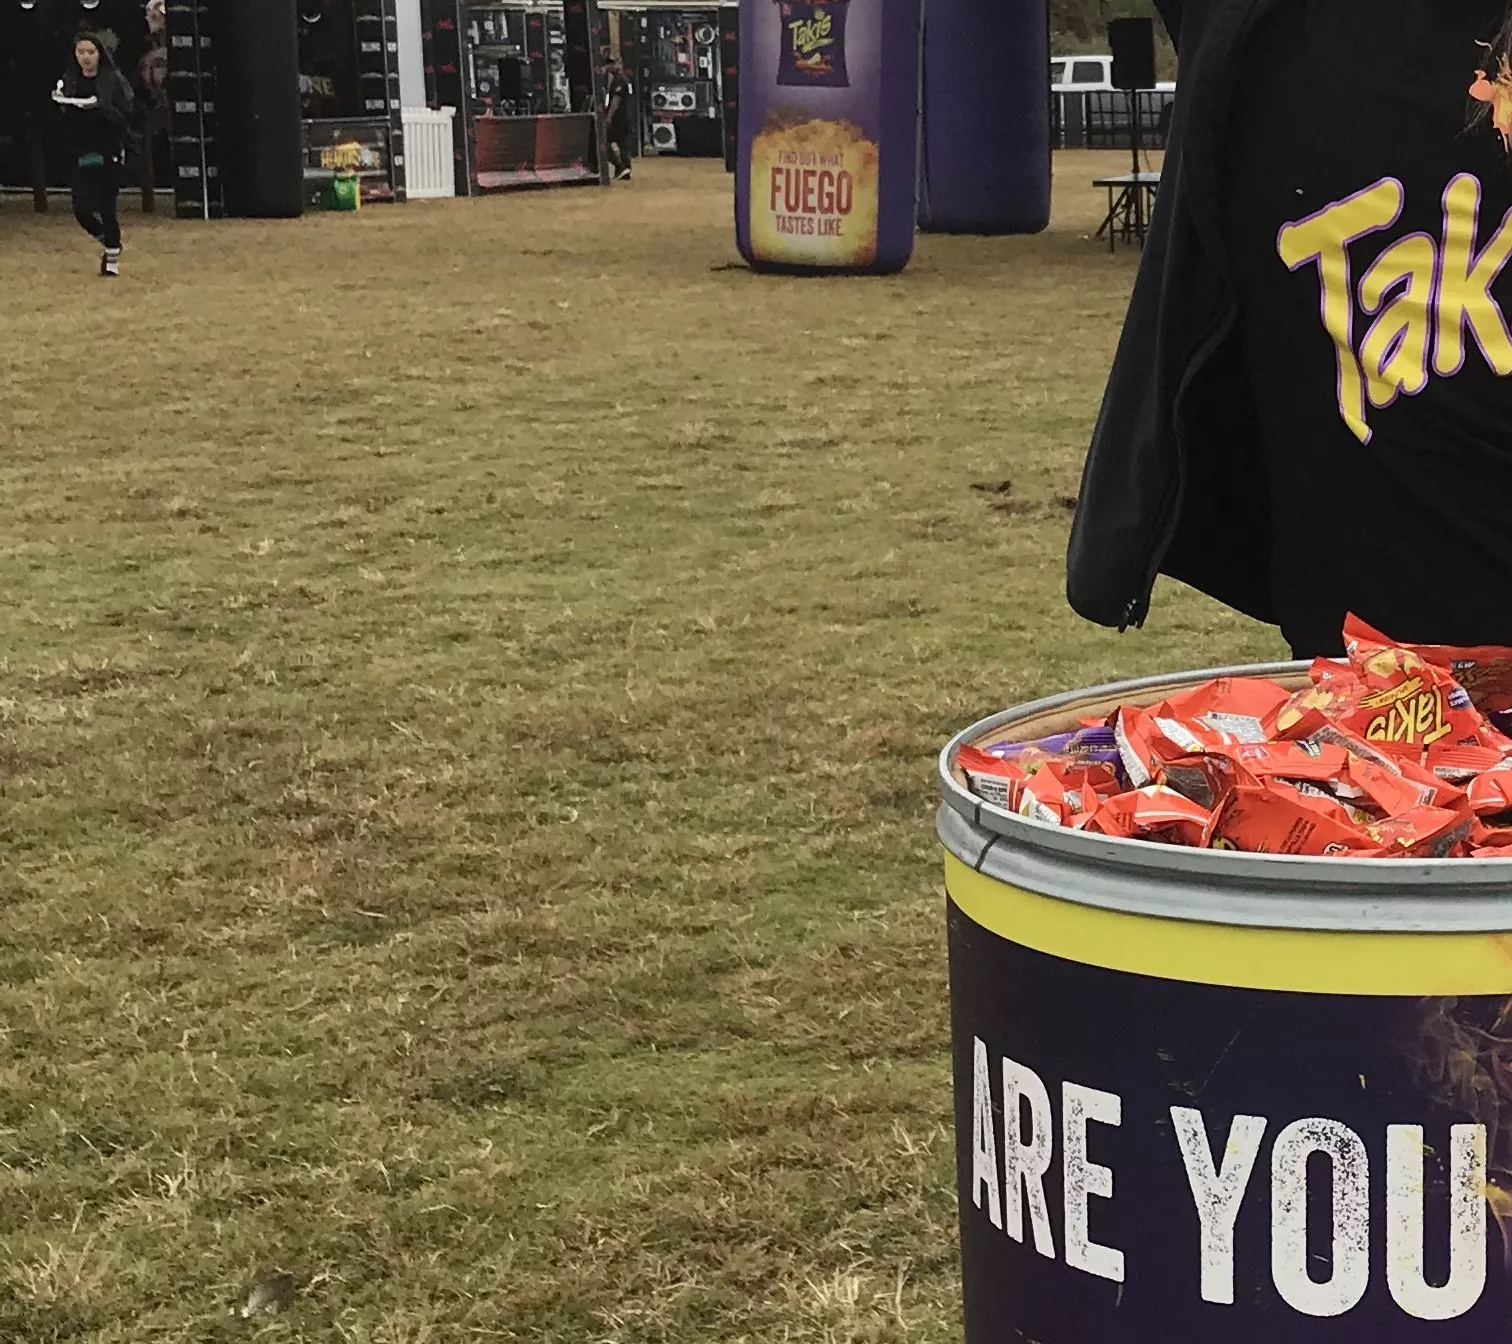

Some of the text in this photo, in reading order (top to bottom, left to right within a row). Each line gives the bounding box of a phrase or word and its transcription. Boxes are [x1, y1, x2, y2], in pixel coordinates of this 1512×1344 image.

[820, 151, 844, 167] WHAT
[770, 166, 853, 215] FUEGO
[775, 215, 844, 236] TASTES LIKE
[970, 1035, 1487, 1321] ARE YOU
